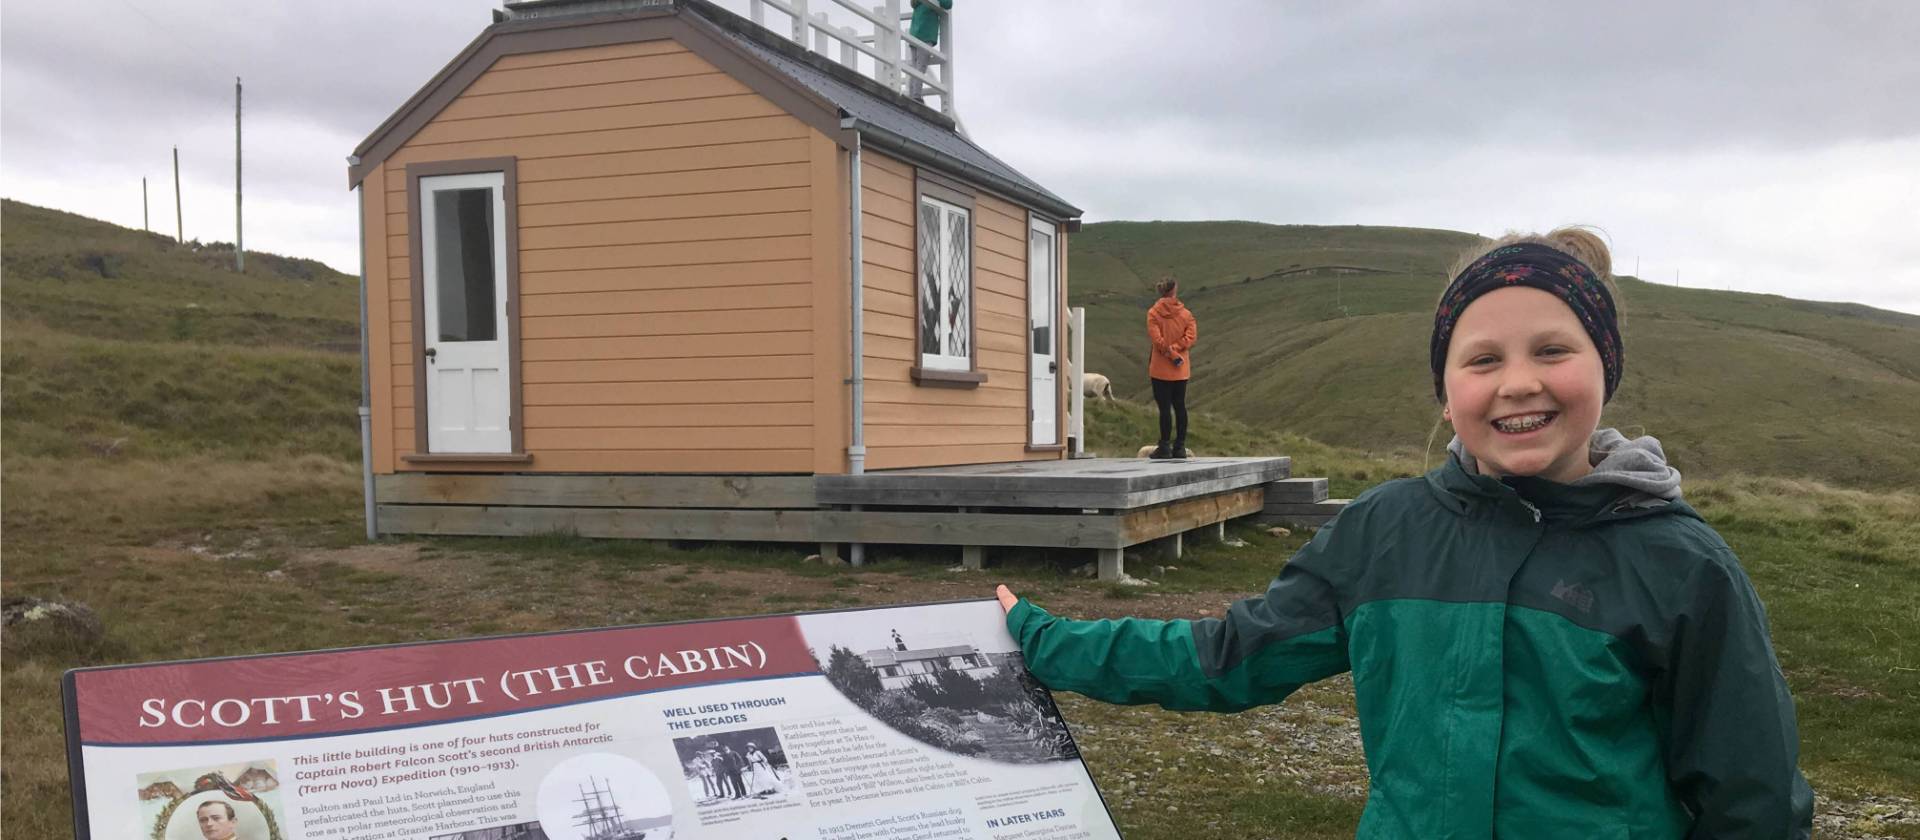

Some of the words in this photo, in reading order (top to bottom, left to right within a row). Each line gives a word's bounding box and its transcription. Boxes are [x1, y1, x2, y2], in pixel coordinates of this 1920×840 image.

[139, 690, 364, 728] SCOTT'S
[375, 677, 486, 715] HUT
[500, 661, 614, 701] (THE
[623, 640, 767, 680] CABIN)
[663, 707, 697, 718] WELL
[698, 703, 728, 714] USED
[730, 697, 786, 710] THROUGH
[667, 720, 692, 730] THE
[694, 714, 748, 728] DECADES
[293, 755, 319, 766] This
[323, 751, 352, 762] little
[355, 745, 406, 759] building
[410, 743, 419, 752] is
[423, 742, 444, 750] one
[447, 738, 460, 749] of
[462, 736, 487, 748] four
[489, 732, 514, 743] huts
[517, 723, 582, 739] constructed
[585, 722, 601, 733] for
[295, 766, 346, 781] Captain
[350, 761, 391, 774] Robert
[395, 756, 435, 768] Falcon
[438, 750, 477, 763] Scott's
[480, 744, 520, 757] second
[523, 740, 560, 752] British
[562, 733, 613, 747] Antarctic
[298, 784, 337, 797] (Terra
[341, 776, 378, 789] Nova)
[382, 769, 446, 785] Expedition
[301, 804, 340, 815] Boulton
[342, 800, 360, 809] and
[362, 796, 384, 806] Paul
[386, 794, 401, 803] Ltd
[403, 793, 413, 801] in
[457, 782, 495, 794] England
[304, 811, 368, 828] prefabricated
[370, 808, 385, 817] the
[411, 801, 436, 811] Scott
[437, 796, 473, 810] planned
[487, 793, 502, 801] use
[504, 790, 521, 798] this
[305, 829, 324, 838] one
[347, 822, 371, 834] polar
[374, 810, 444, 828] meteorological
[445, 804, 499, 817] observation
[501, 801, 518, 809] and
[986, 818, 999, 829] IN
[1000, 813, 1032, 826] LATER
[1032, 808, 1065, 820] YEARS
[349, 830, 384, 840] station
[386, 830, 396, 839] at
[398, 825, 433, 837] Granite
[478, 816, 499, 825] This
